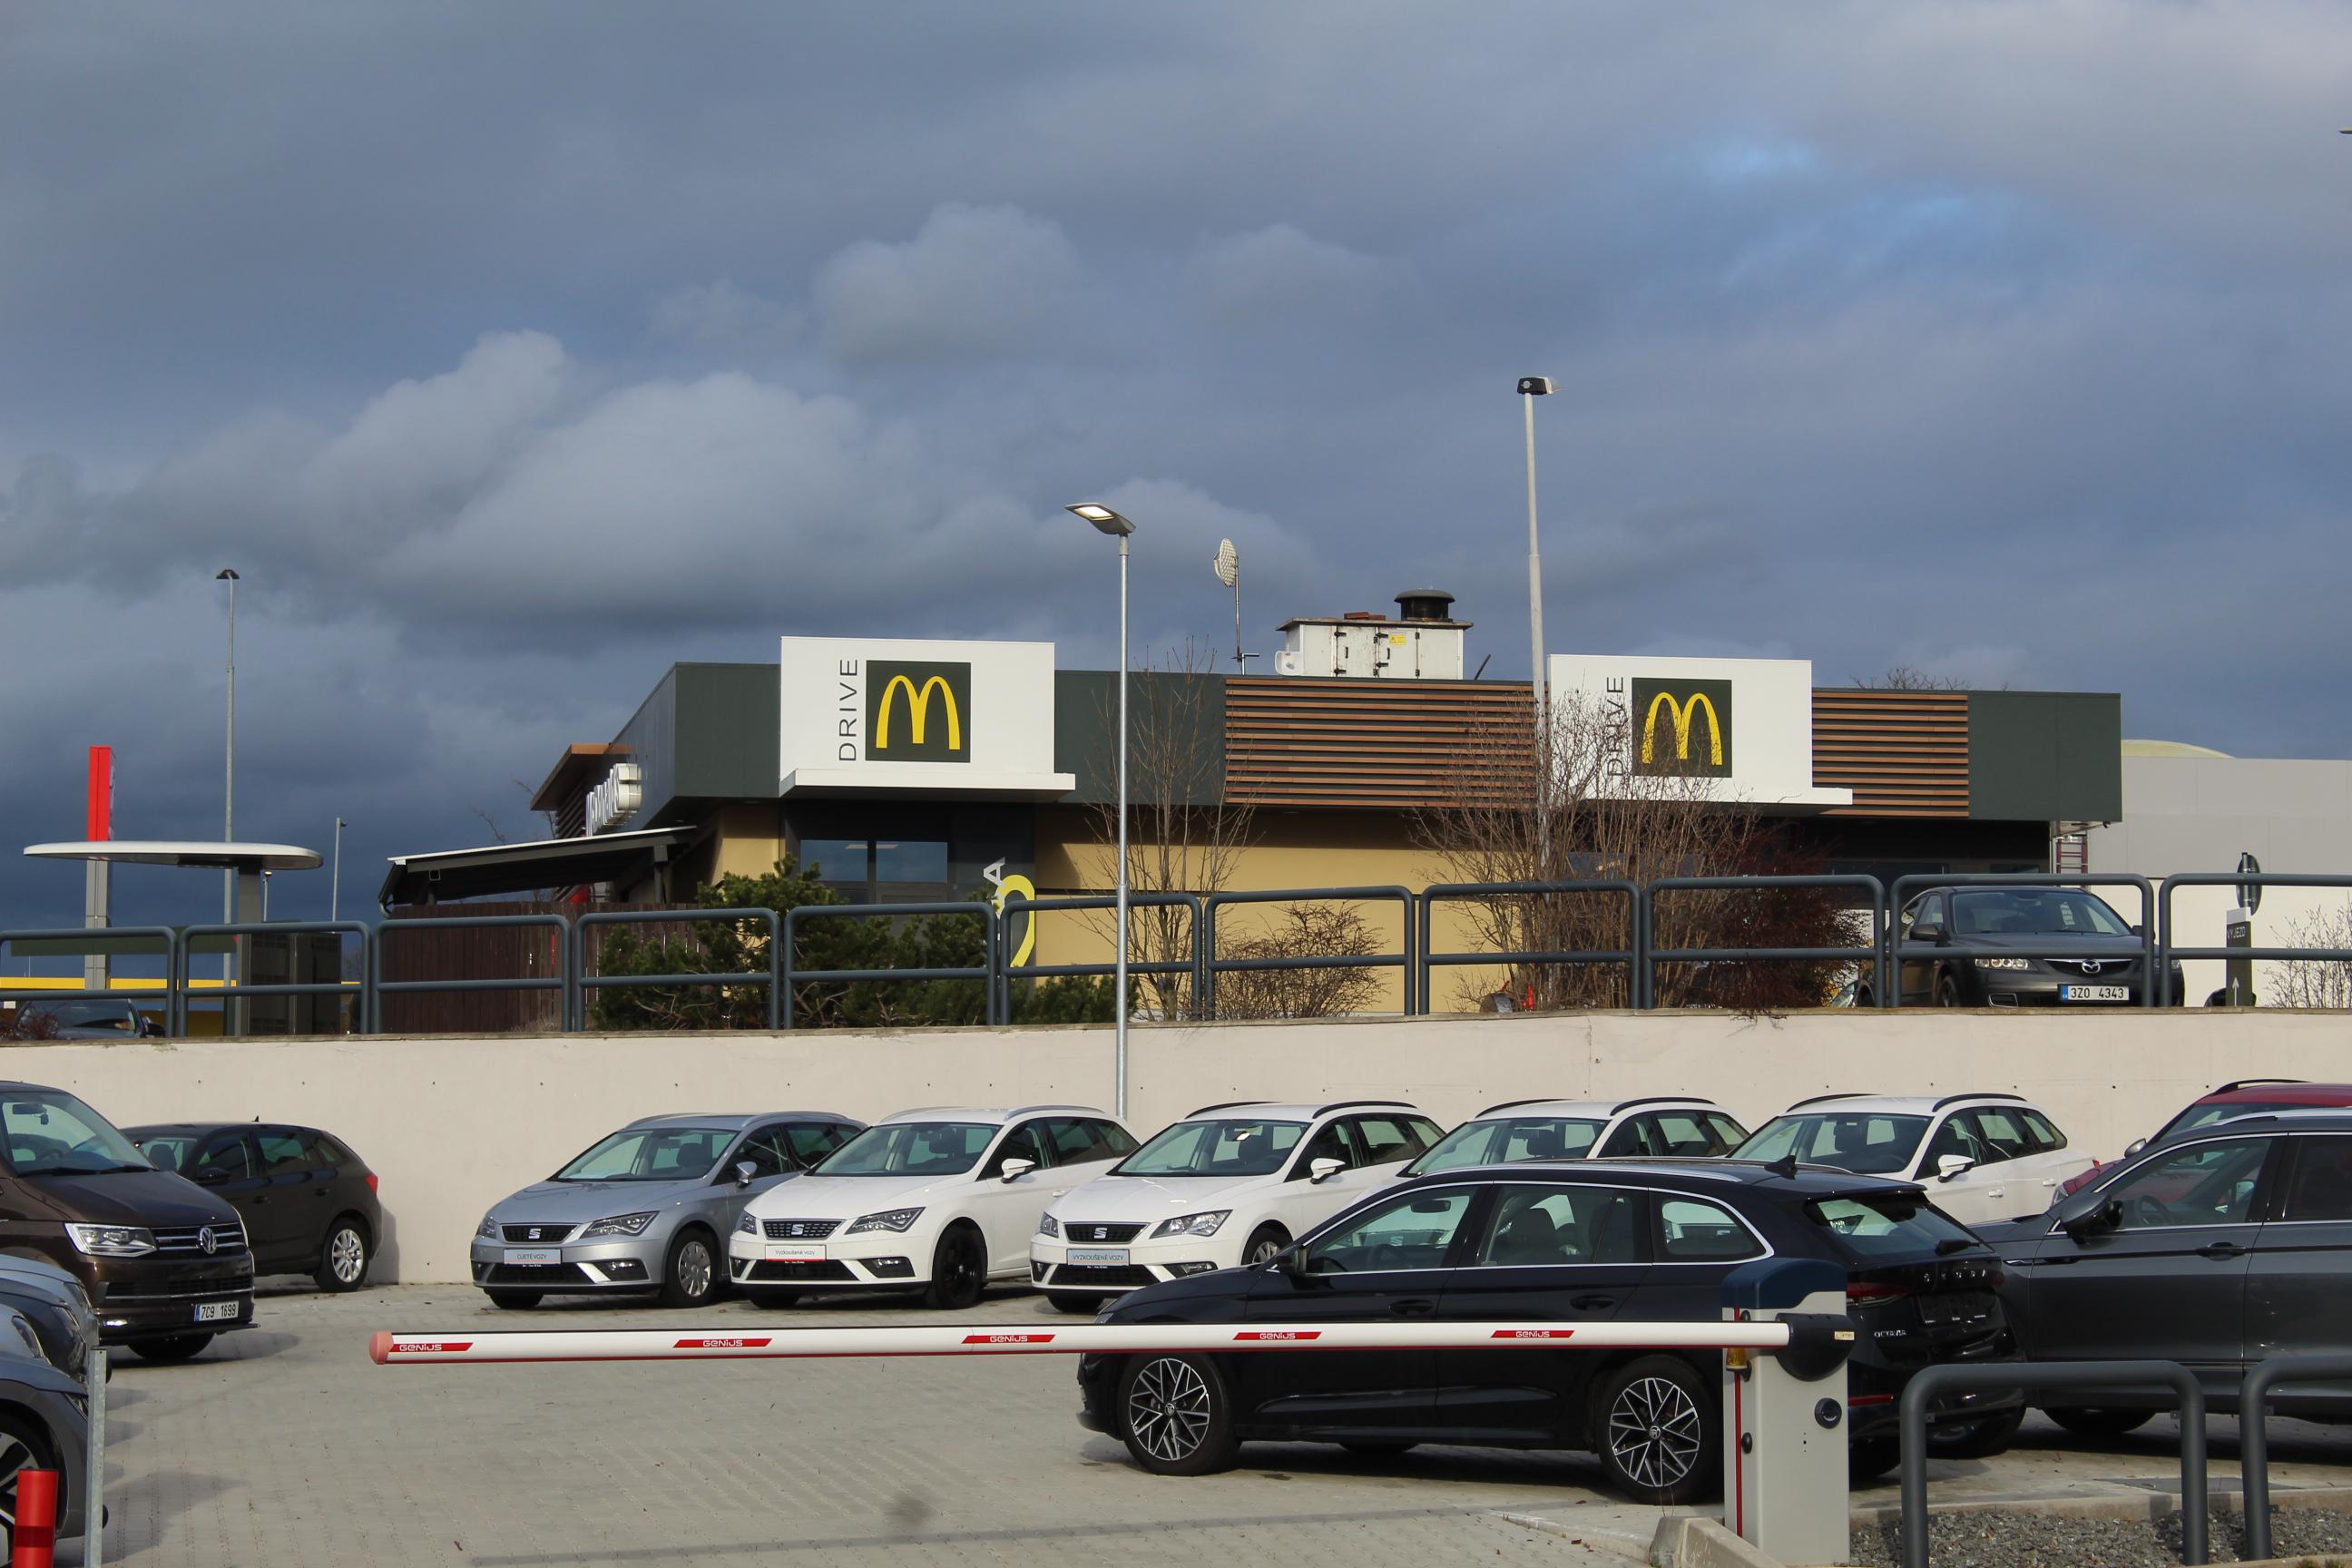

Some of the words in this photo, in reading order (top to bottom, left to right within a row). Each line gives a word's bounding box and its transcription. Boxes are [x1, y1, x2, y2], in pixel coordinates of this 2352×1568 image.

[838, 659, 858, 761] DRIVE
[1606, 676, 1623, 776] DRIVE
[2098, 987, 2124, 998] 4343
[1073, 1253, 1109, 1261] VYZKOUŠENÉ
[201, 1306, 215, 1318] 7C9
[220, 1304, 236, 1317] 1699
